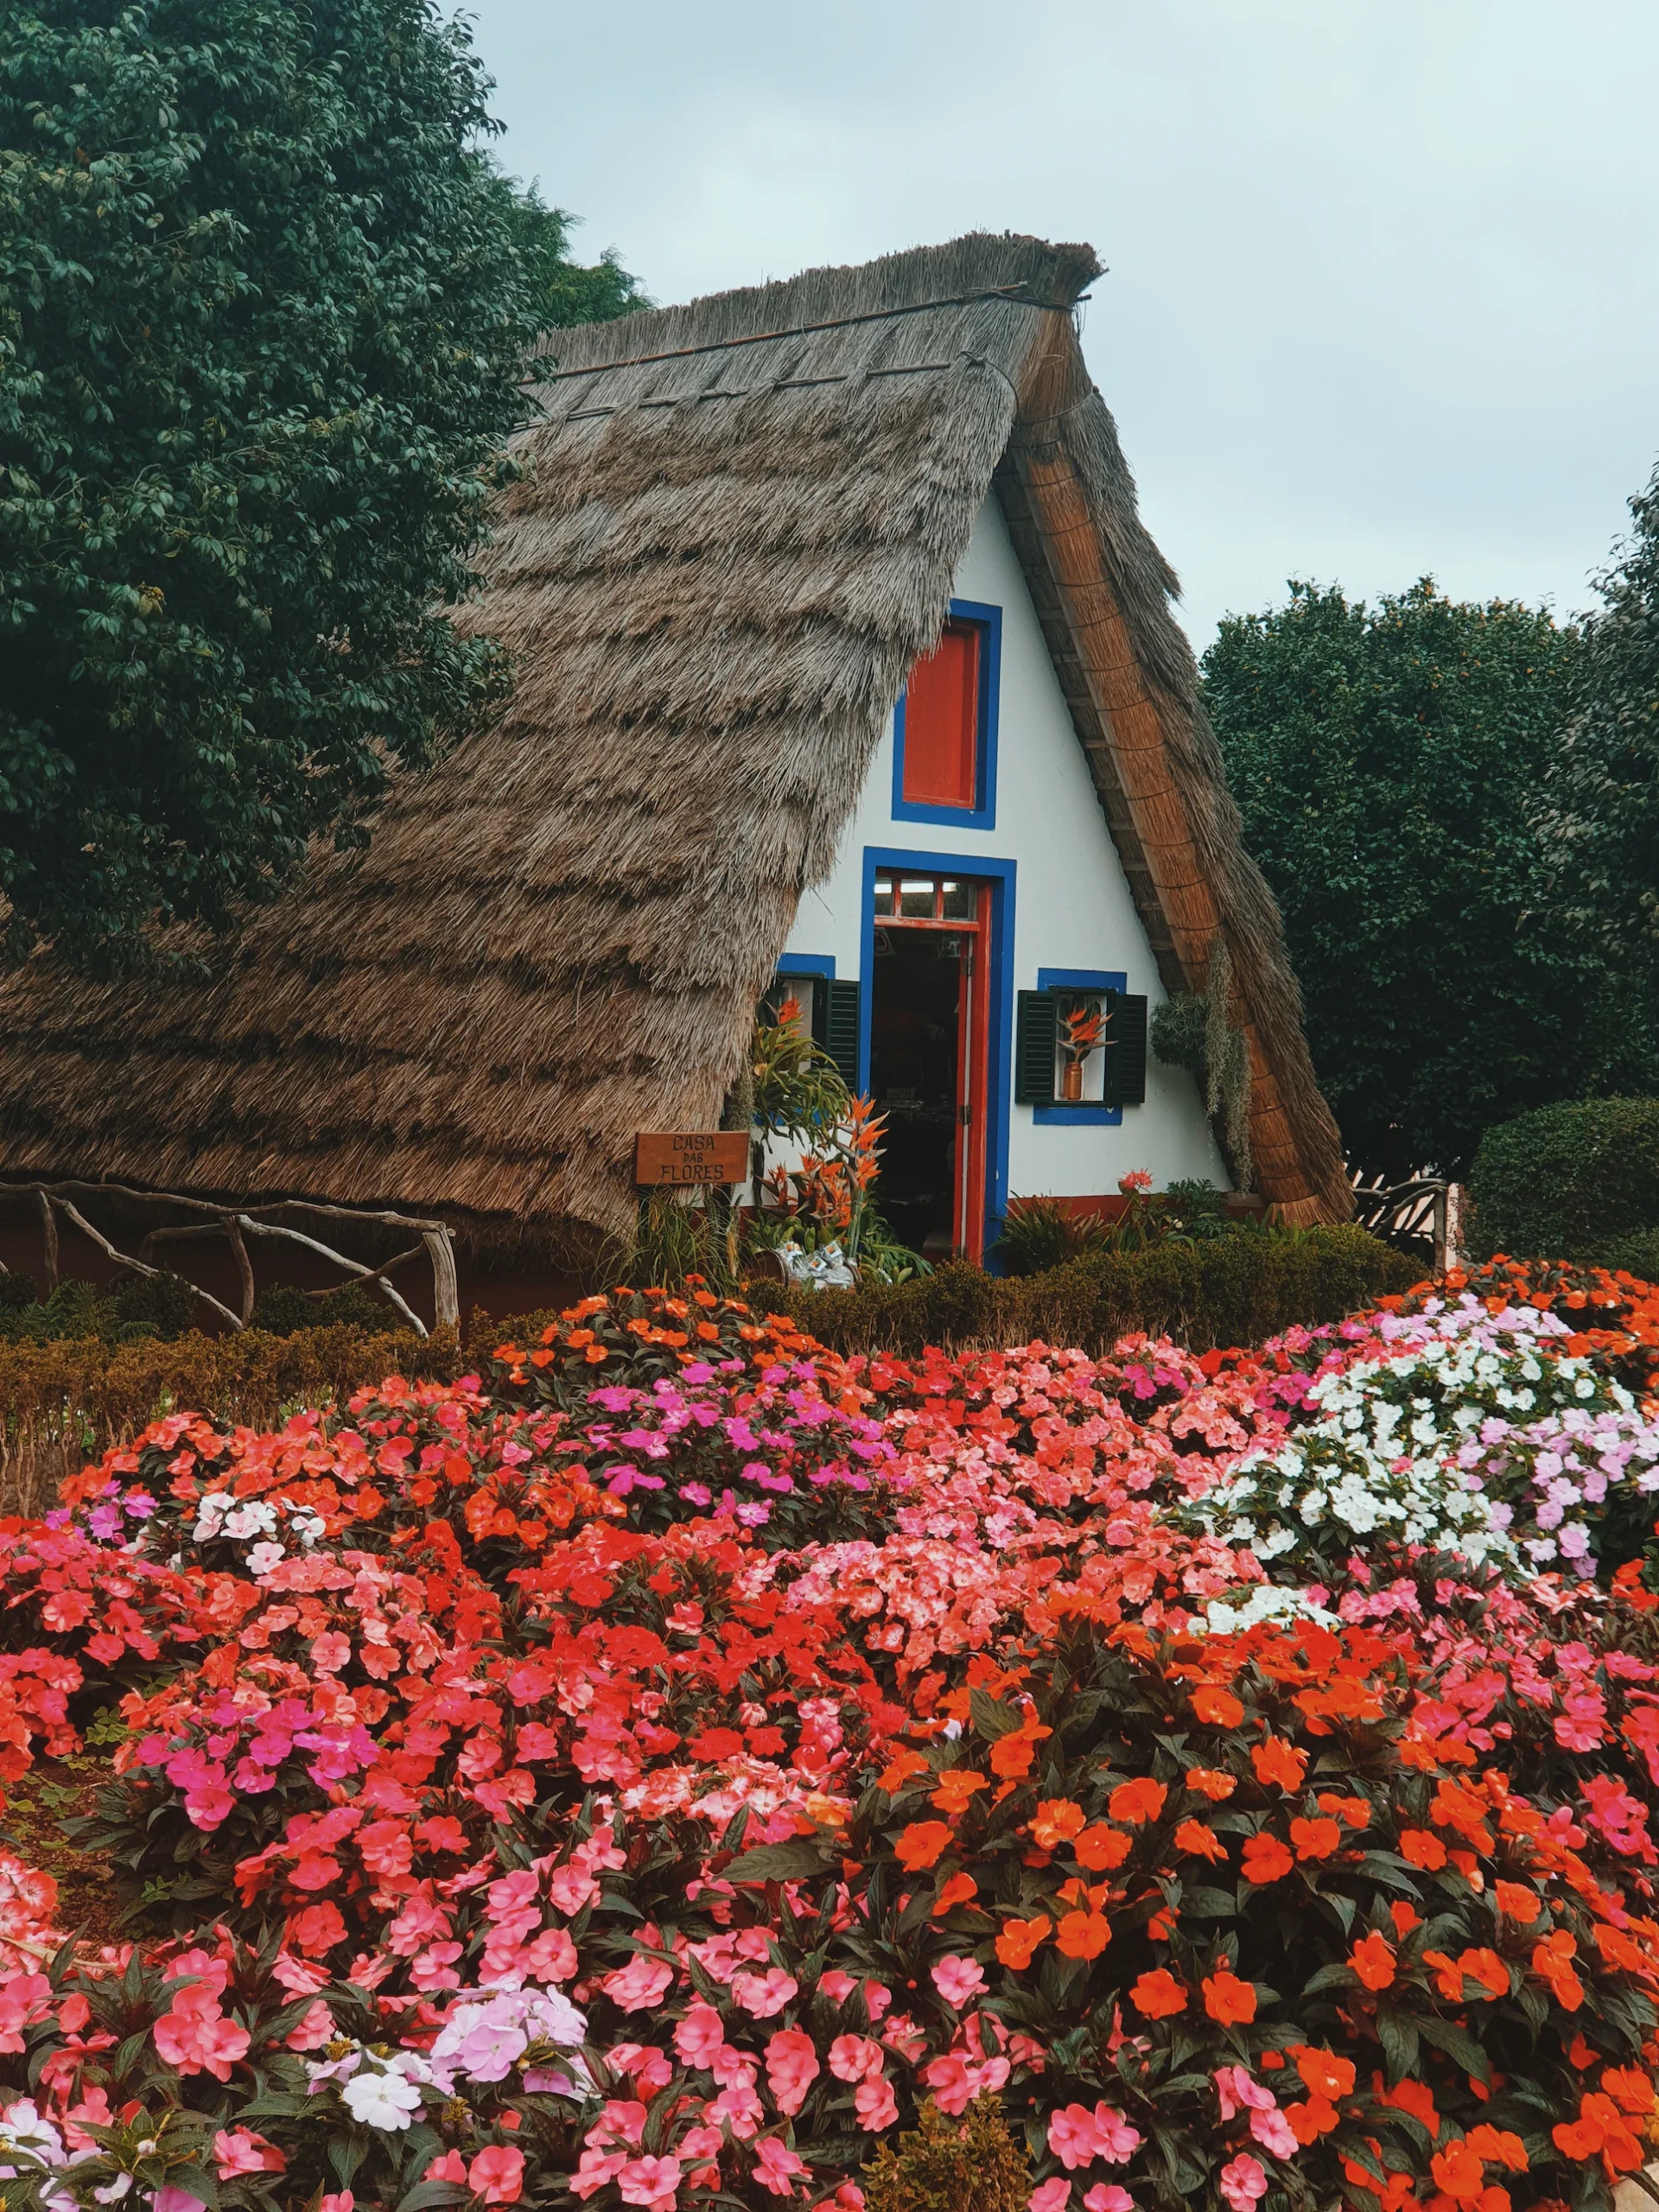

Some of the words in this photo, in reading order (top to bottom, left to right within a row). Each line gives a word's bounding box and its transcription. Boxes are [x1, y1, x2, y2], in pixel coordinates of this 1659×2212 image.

[673, 1135, 715, 1151] CASA
[683, 1153, 703, 1163] DAS
[661, 1165, 724, 1180] FLORES
